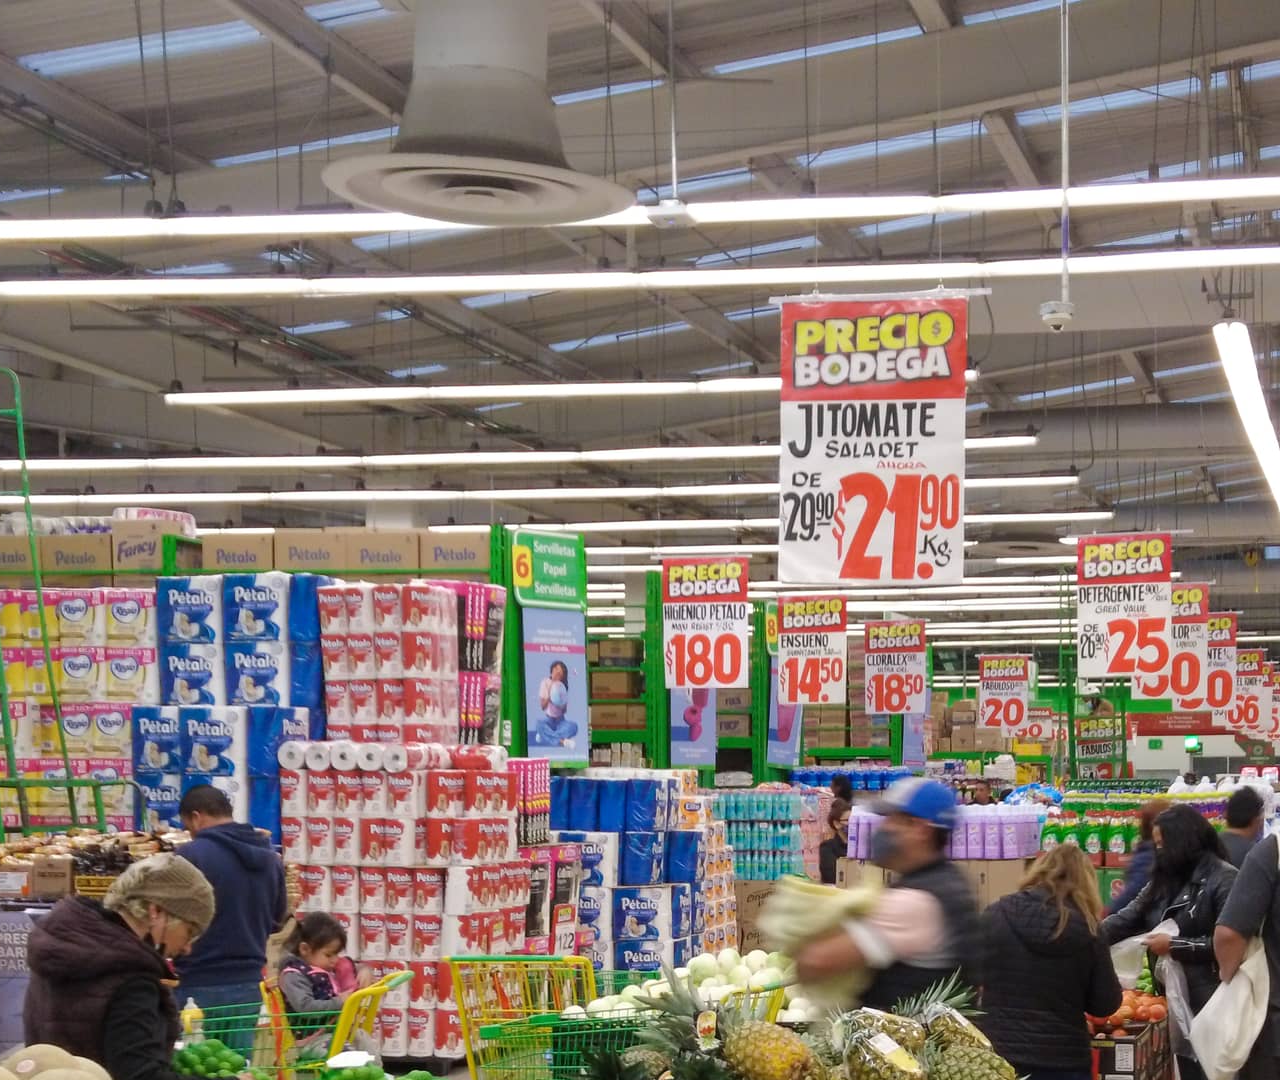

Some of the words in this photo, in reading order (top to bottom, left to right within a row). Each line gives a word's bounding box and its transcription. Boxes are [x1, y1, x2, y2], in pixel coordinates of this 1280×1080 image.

[794, 310, 954, 356] PRECIO
[794, 347, 951, 388] BODEGA
[788, 402, 936, 458] JITOMATE
[825, 440, 918, 458] SALADET
[877, 461, 927, 469] AHORA
[792, 472, 821, 487] DE
[116, 540, 157, 562] Fancy
[533, 540, 576, 557] Servilletas
[1084, 539, 1165, 562] PRECIO
[516, 553, 529, 578] 6
[543, 562, 567, 577] Papel
[670, 562, 742, 582] PRECIO
[1084, 557, 1163, 578] BODEGA
[535, 582, 577, 597] Servilletas
[669, 580, 740, 597] BODEGA
[1079, 585, 1144, 604] DETERGENTE
[664, 604, 707, 620] HIGIENICO
[710, 604, 746, 620] PETALO
[783, 599, 843, 615] PRECIO
[783, 611, 841, 629] BODEGA
[1083, 624, 1099, 632] DE
[767, 621, 776, 637] 8
[869, 624, 921, 639] PRECIO
[869, 635, 920, 649] BODEGA
[867, 654, 907, 666] CLORALEX
[983, 659, 1025, 668] PRECIO
[983, 668, 1024, 677] BODEGA
[622, 897, 658, 910] Pétalo
[624, 950, 661, 963] Pétalo
